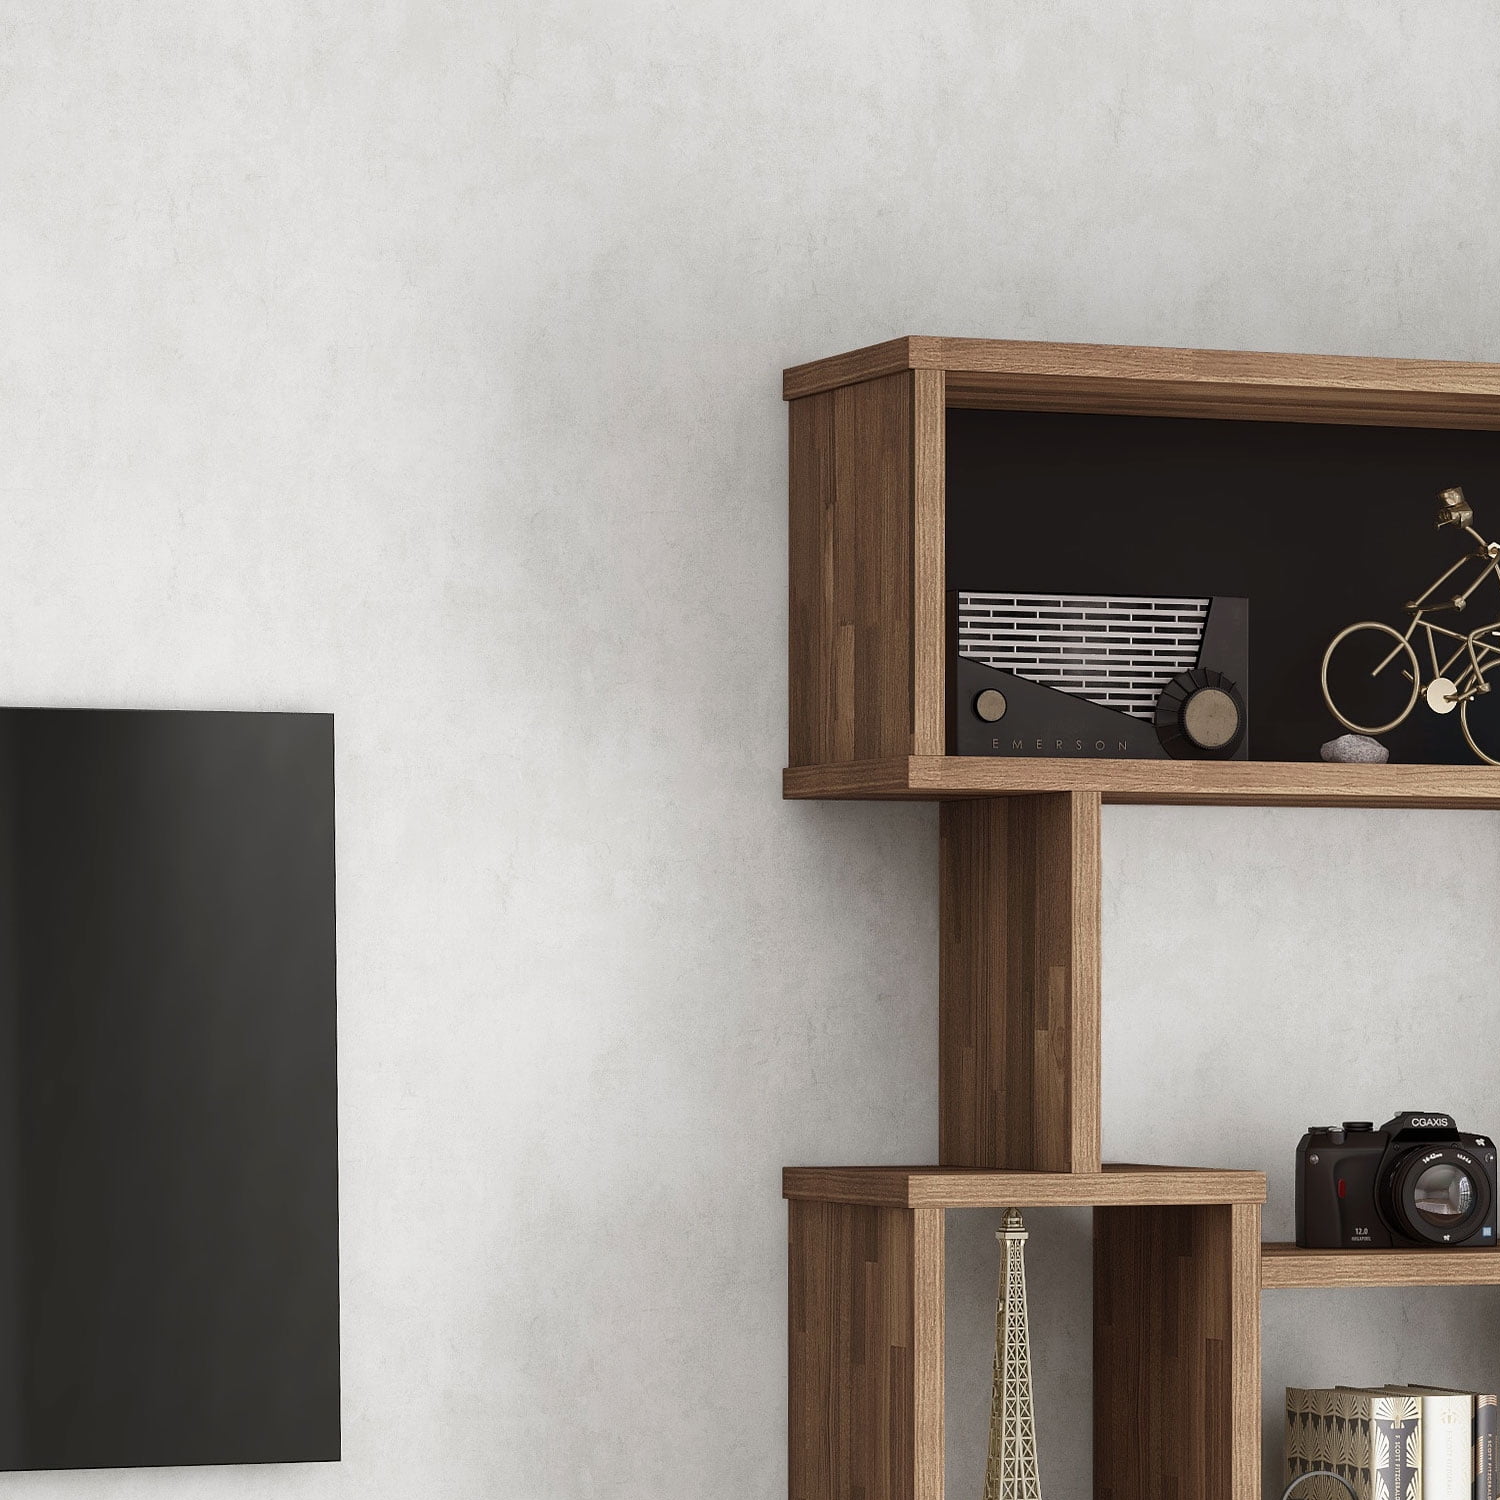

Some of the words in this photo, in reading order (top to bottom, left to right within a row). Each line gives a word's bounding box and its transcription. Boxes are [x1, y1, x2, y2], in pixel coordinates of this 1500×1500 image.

[992, 738, 1128, 751] EMERSON
[1411, 1118, 1449, 1127] CGAXIS
[1355, 1227, 1369, 1235] 12.0
